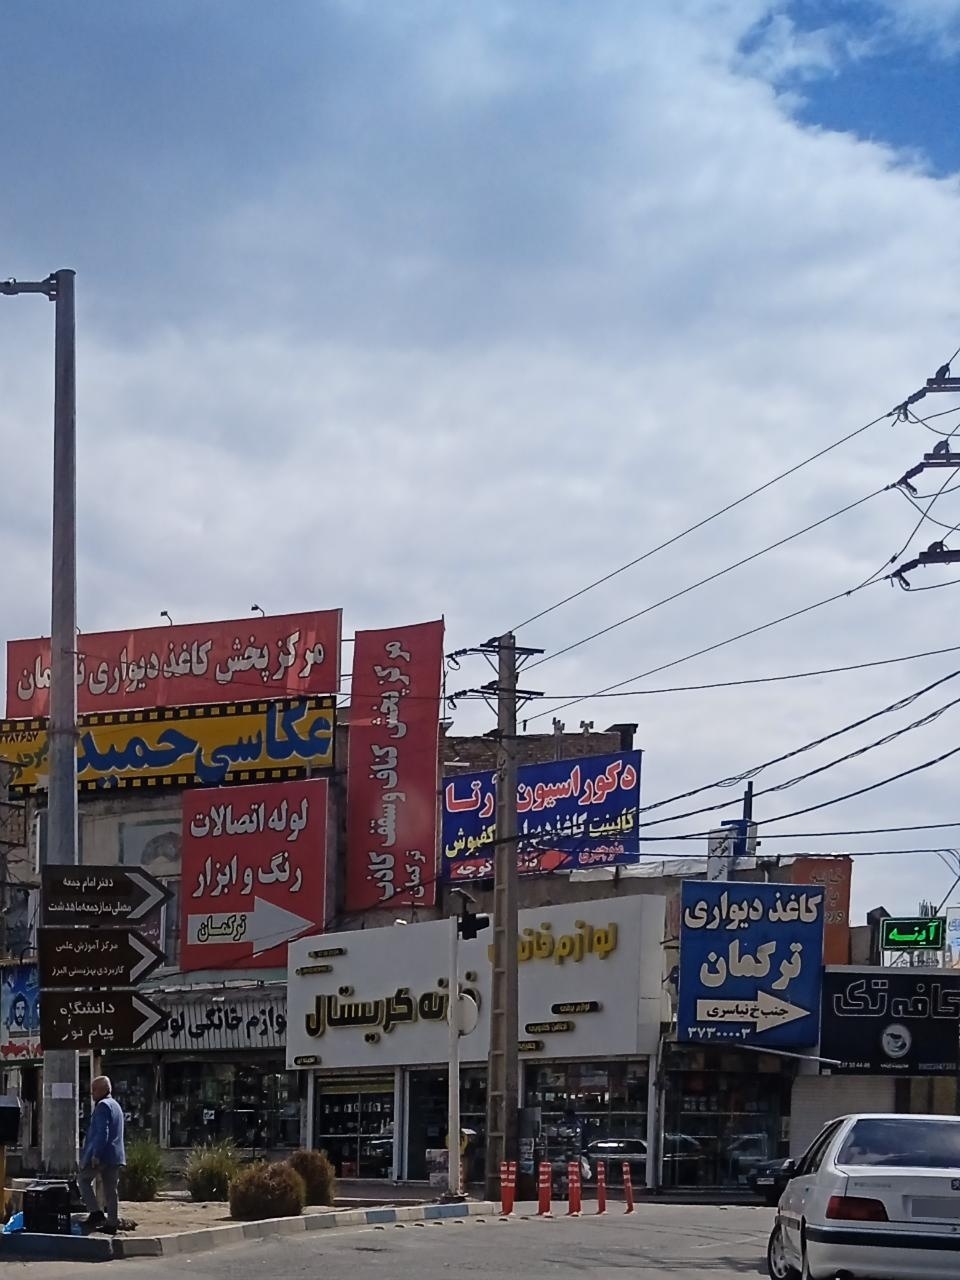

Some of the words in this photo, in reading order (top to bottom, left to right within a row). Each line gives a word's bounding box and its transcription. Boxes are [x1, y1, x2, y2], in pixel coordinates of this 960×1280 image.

[89, 648, 160, 695] دیواری
[162, 639, 213, 677] کاغذ
[215, 635, 269, 685] پخش
[272, 631, 325, 680] مرکز
[76, 728, 198, 788] حمید
[194, 701, 332, 787] عکاسی
[516, 759, 638, 813] دکوراسیون
[190, 802, 265, 838] اتصالات
[268, 797, 309, 841] لوله
[62, 877, 81, 890] جمعه
[82, 876, 96, 893] امام
[96, 877, 114, 890] دفتر
[192, 855, 238, 898] ابزار
[240, 866, 253, 895] و
[257, 851, 303, 892] رنگ
[684, 890, 764, 931] دیواری
[768, 891, 823, 924] کاغذ
[197, 914, 248, 943] ترکمان
[554, 919, 618, 965] لوازم
[888, 919, 939, 945] آینه
[55, 940, 73, 952] علمی
[73, 939, 100, 953] آموزش
[101, 940, 119, 952] مرکز
[51, 966, 68, 977] البرز
[68, 965, 97, 977] بهزیستی
[96, 965, 125, 976] کاربردی
[699, 938, 803, 990] ترکمان
[706, 1003, 750, 1019] نیاسری
[749, 1004, 760, 1019] خ
[760, 1003, 789, 1020] جنب
[833, 979, 889, 1017] تک
[188, 1007, 243, 1039] خانگی
[246, 1005, 287, 1040] وازم
[304, 986, 419, 1044] کریستال
[88, 1024, 115, 1044] پیام
[687, 1026, 751, 1040] ۳۷۳۰۰۰۰۳
